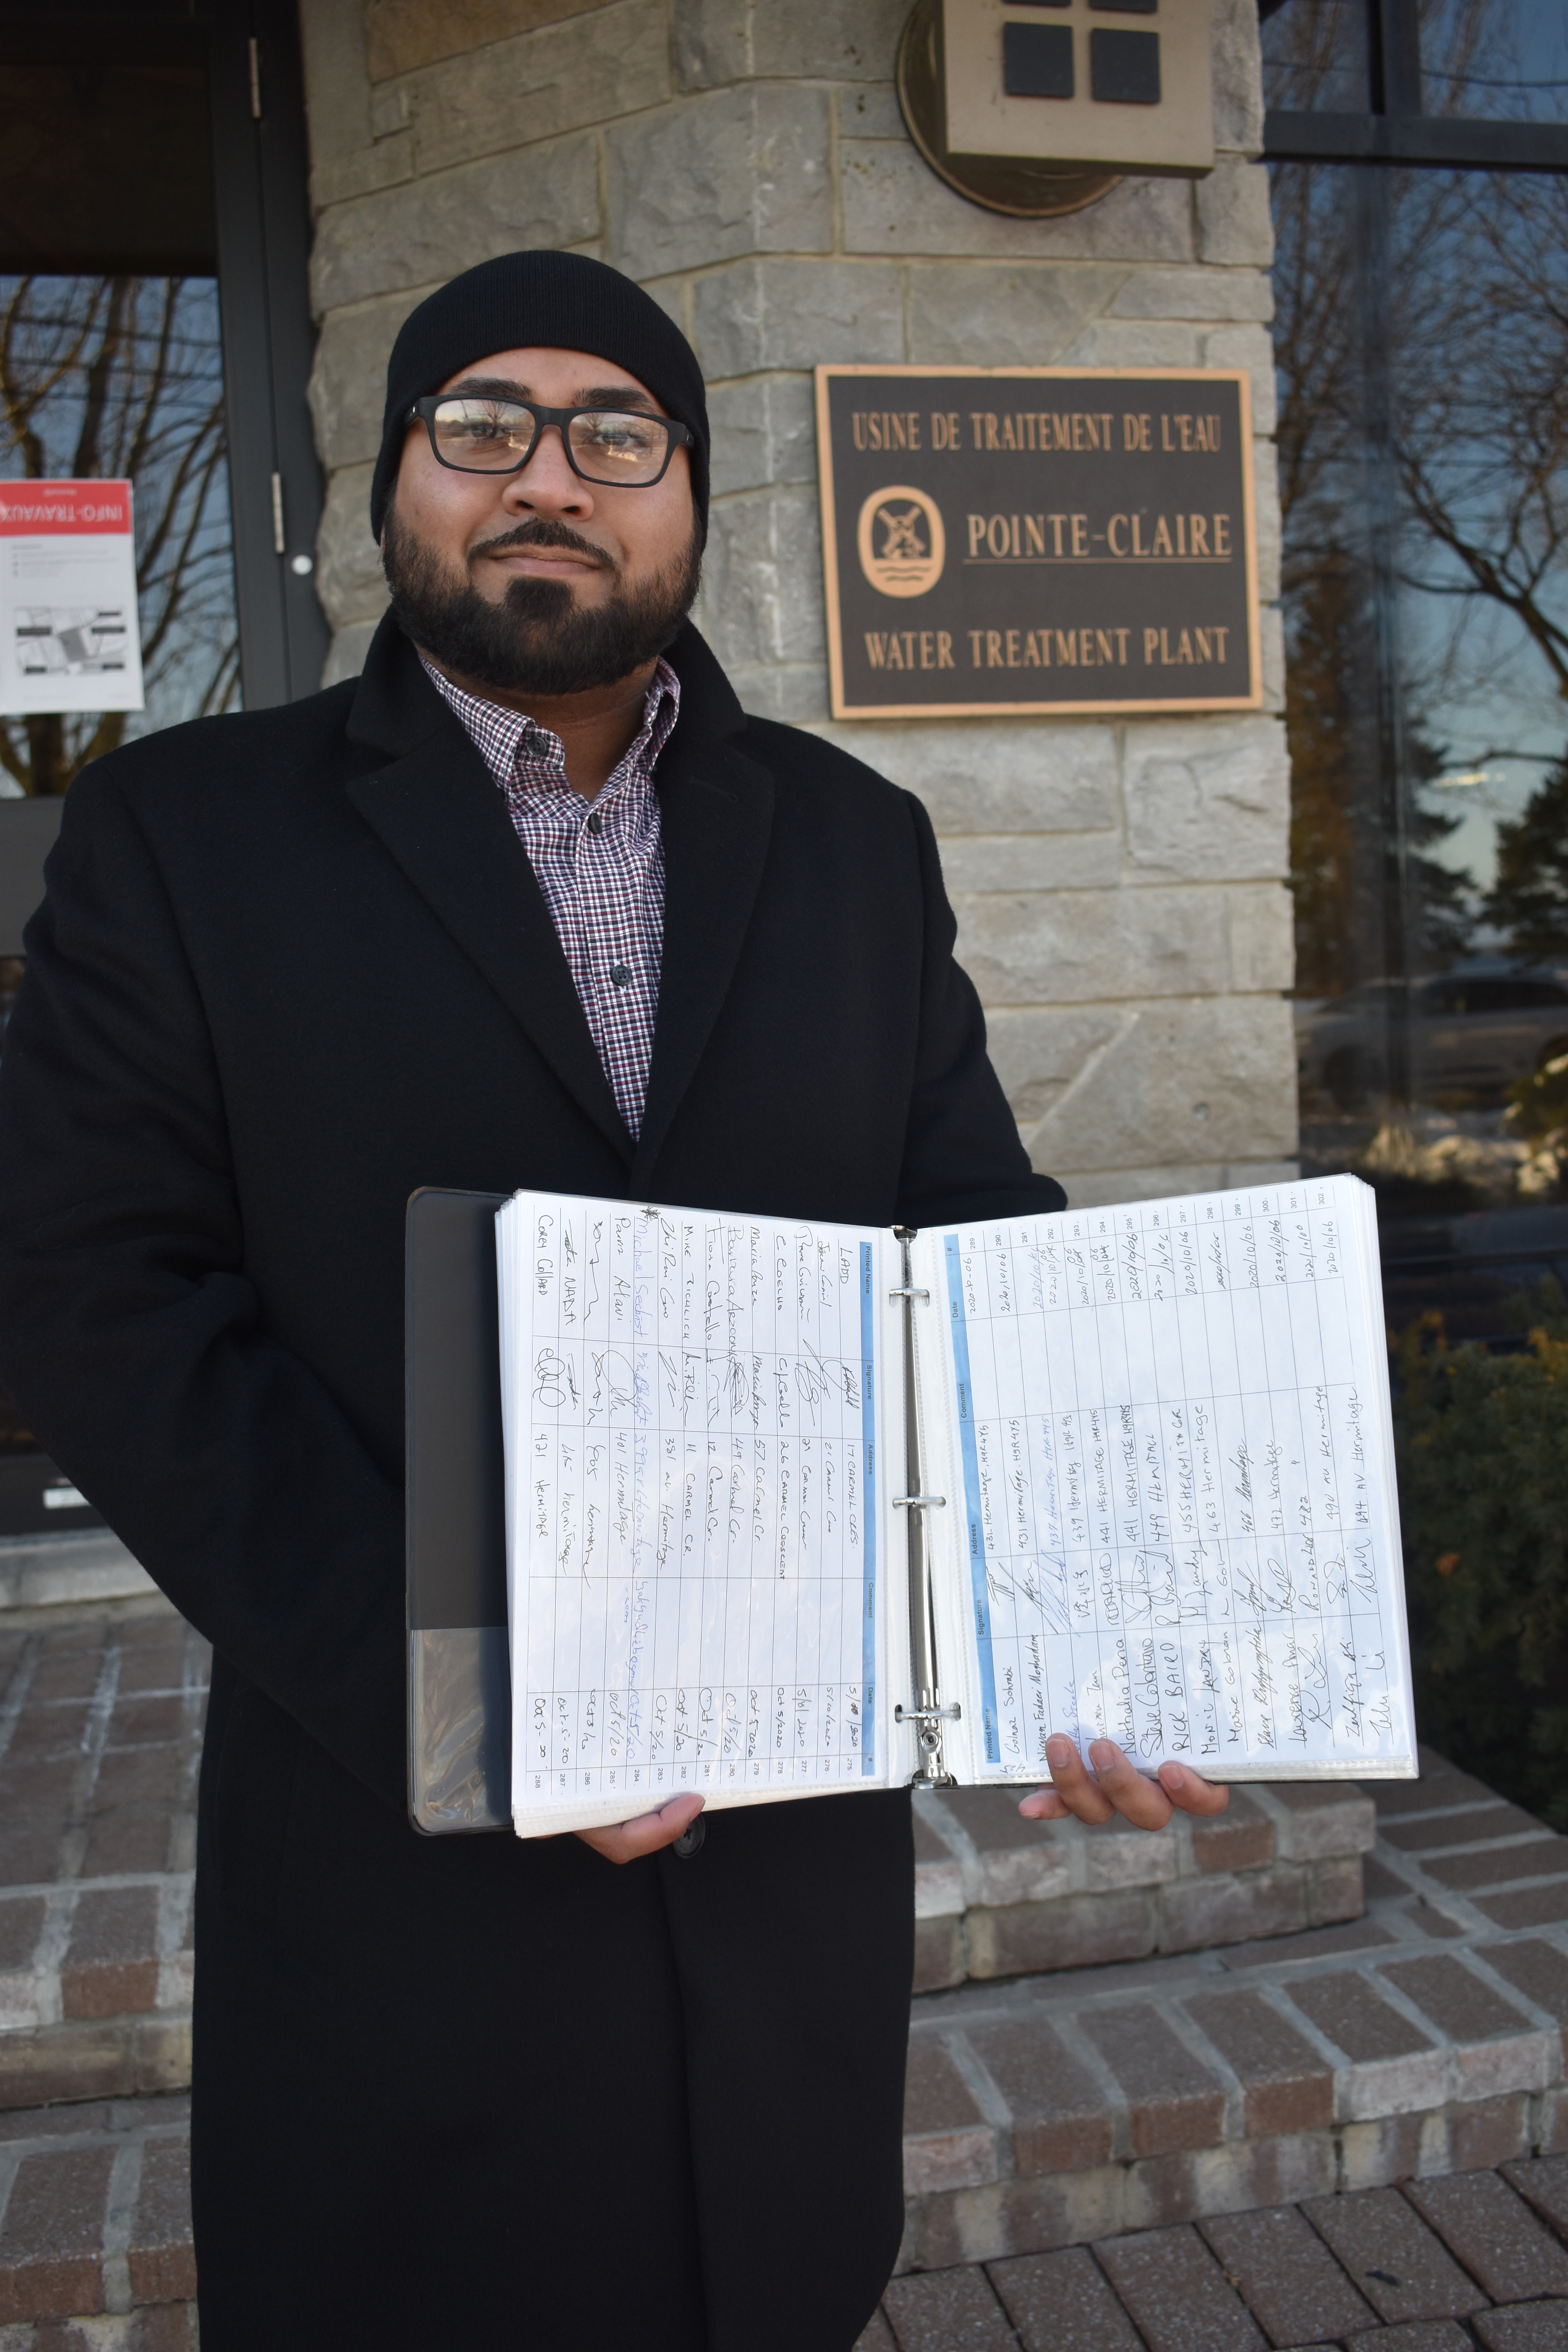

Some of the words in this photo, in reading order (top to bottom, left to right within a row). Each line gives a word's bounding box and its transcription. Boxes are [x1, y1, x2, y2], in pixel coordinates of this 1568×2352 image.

[851, 412, 922, 452] USINE
[931, 412, 962, 452] DE
[970, 412, 1113, 452] TRAITEMENT
[1123, 414, 1152, 452] DE
[1161, 414, 1221, 452] L'EAU
[966, 514, 1232, 557] POINTE-CLAIRE
[864, 631, 955, 670] WATER
[969, 629, 1131, 668] TREATMENT
[1143, 628, 1229, 665] PLANT
[634, 1217, 654, 1279] Michael
[839, 1248, 852, 1284] LADD
[534, 1434, 547, 1457] 421
[616, 1432, 627, 1453] 401
[665, 1438, 676, 1461] 381
[708, 1441, 715, 1455] 12
[732, 1438, 742, 1459] 49
[754, 1439, 765, 1461] 57
[780, 1441, 789, 1464] 26
[847, 1444, 854, 1457] 17
[848, 1461, 857, 1509] CARMEL
[1096, 1446, 1108, 1512] HERMITAGE
[685, 1473, 695, 1521] CARMEL
[1071, 1517, 1085, 1542] 439
[1124, 1518, 1139, 1541] 441
[1207, 1501, 1220, 1532] 463
[1018, 1528, 1028, 1548] 431
[1100, 1522, 1110, 1543] 441
[976, 1599, 985, 1635] Signature
[1160, 1641, 1183, 1697] BAIRD
[1169, 1711, 1190, 1750] RICK
